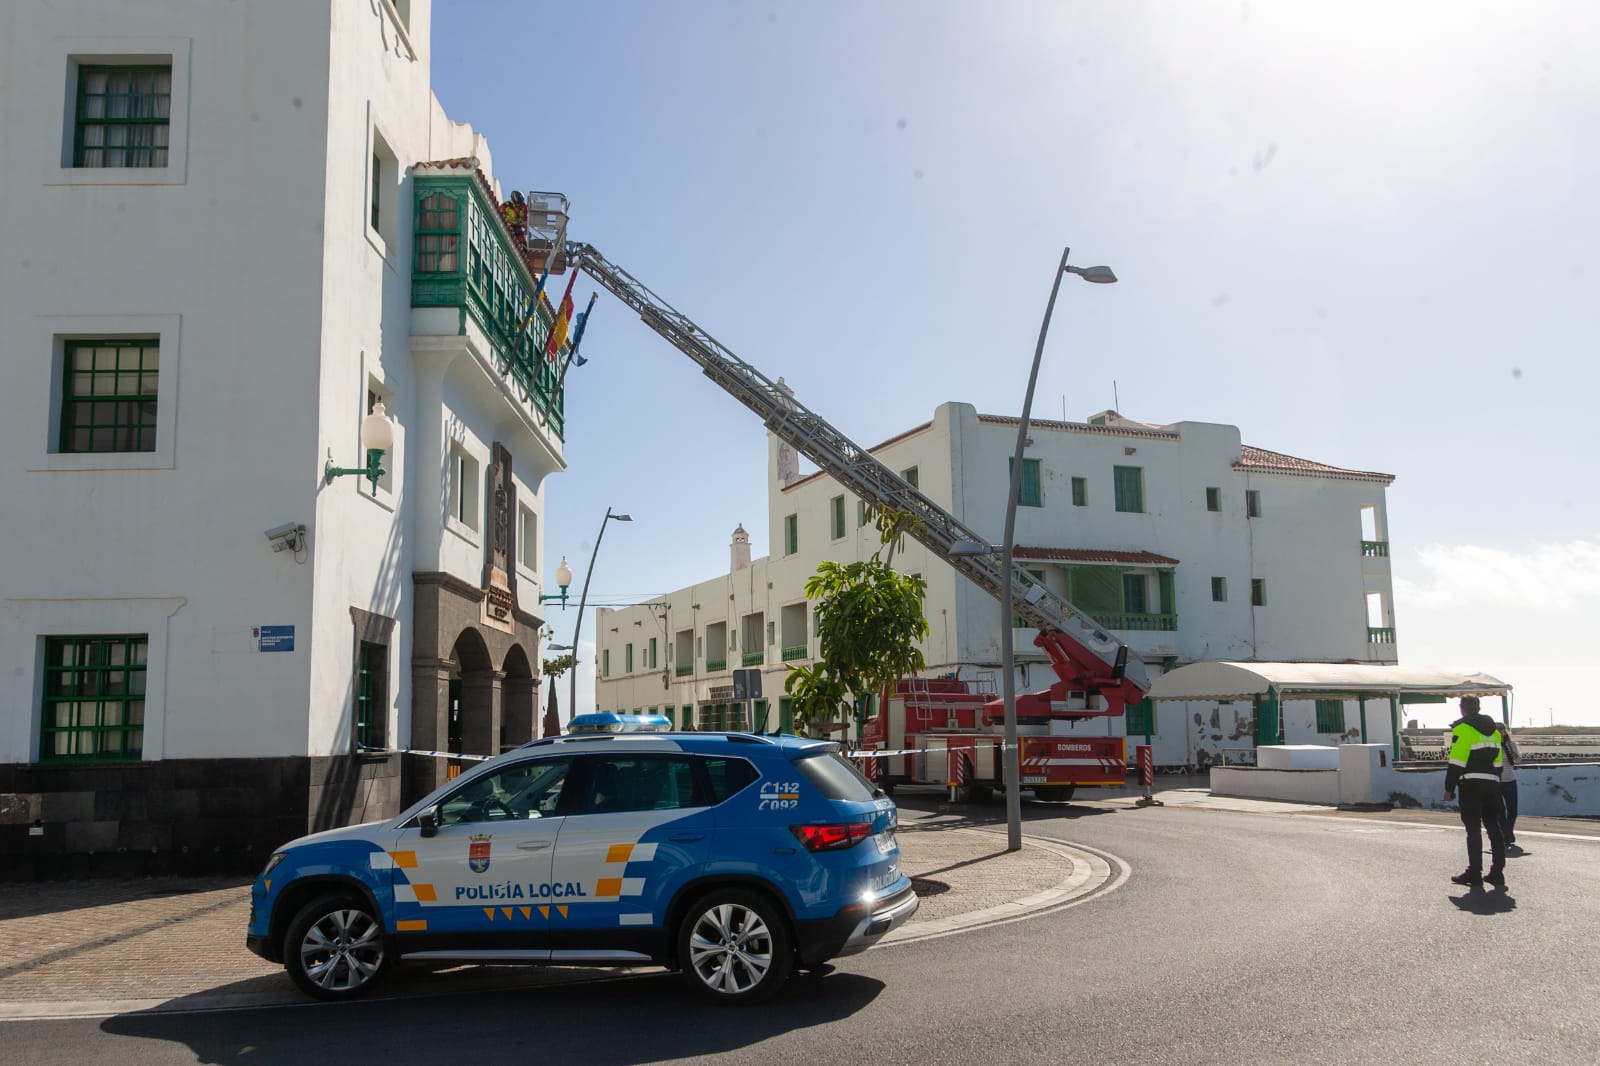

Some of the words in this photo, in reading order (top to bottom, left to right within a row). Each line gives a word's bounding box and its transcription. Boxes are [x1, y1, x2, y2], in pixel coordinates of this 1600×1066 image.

[1057, 743, 1091, 751] BOMBEROS
[455, 881, 525, 900] POLICÍA
[529, 881, 587, 898] LOCAL
